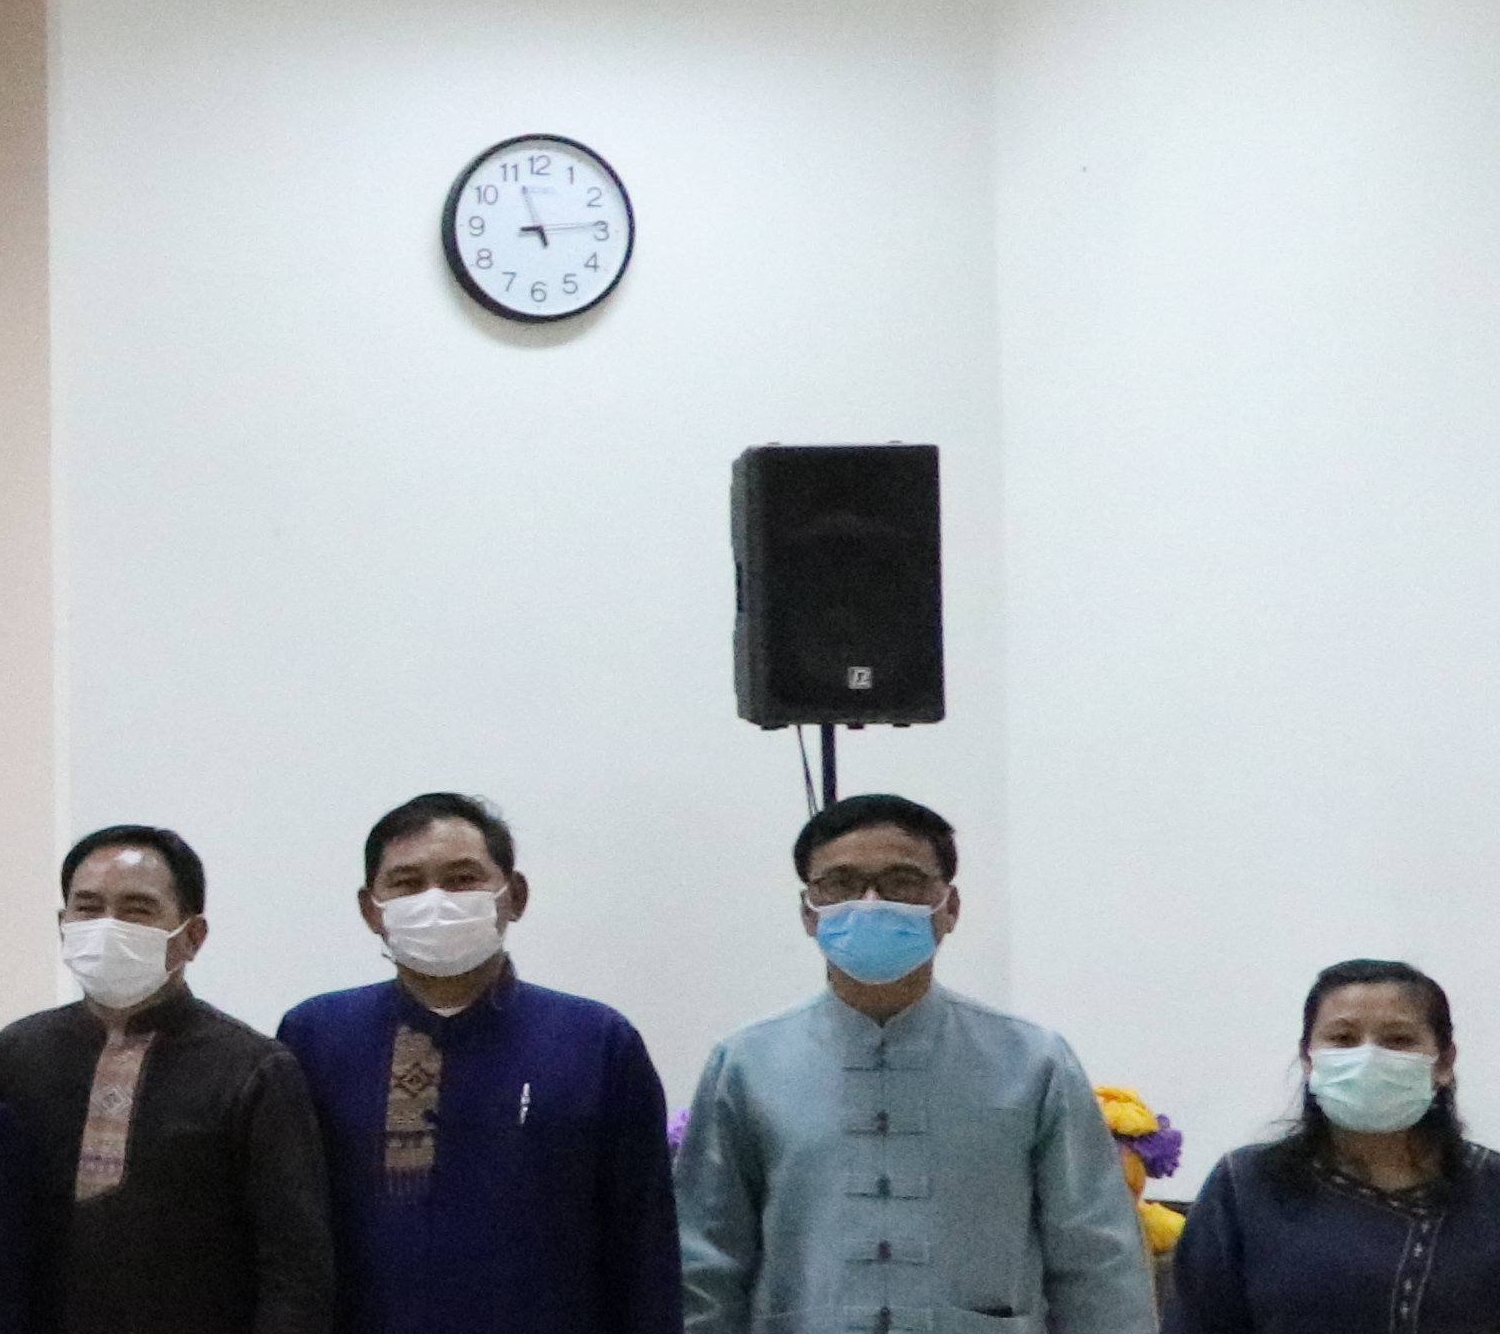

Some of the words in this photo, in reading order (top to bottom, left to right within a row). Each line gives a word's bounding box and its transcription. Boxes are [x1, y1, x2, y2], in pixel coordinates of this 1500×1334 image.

[500, 162, 519, 182] 11
[529, 154, 551, 176] 12
[567, 166, 575, 185] 1
[475, 184, 499, 206] 10
[586, 186, 603, 208] 2
[468, 215, 486, 237] 9
[592, 220, 610, 242] 3
[475, 248, 494, 270] 8
[583, 251, 601, 273] 4
[501, 271, 518, 292] 7
[529, 281, 547, 303] 6
[562, 273, 579, 295] 5
